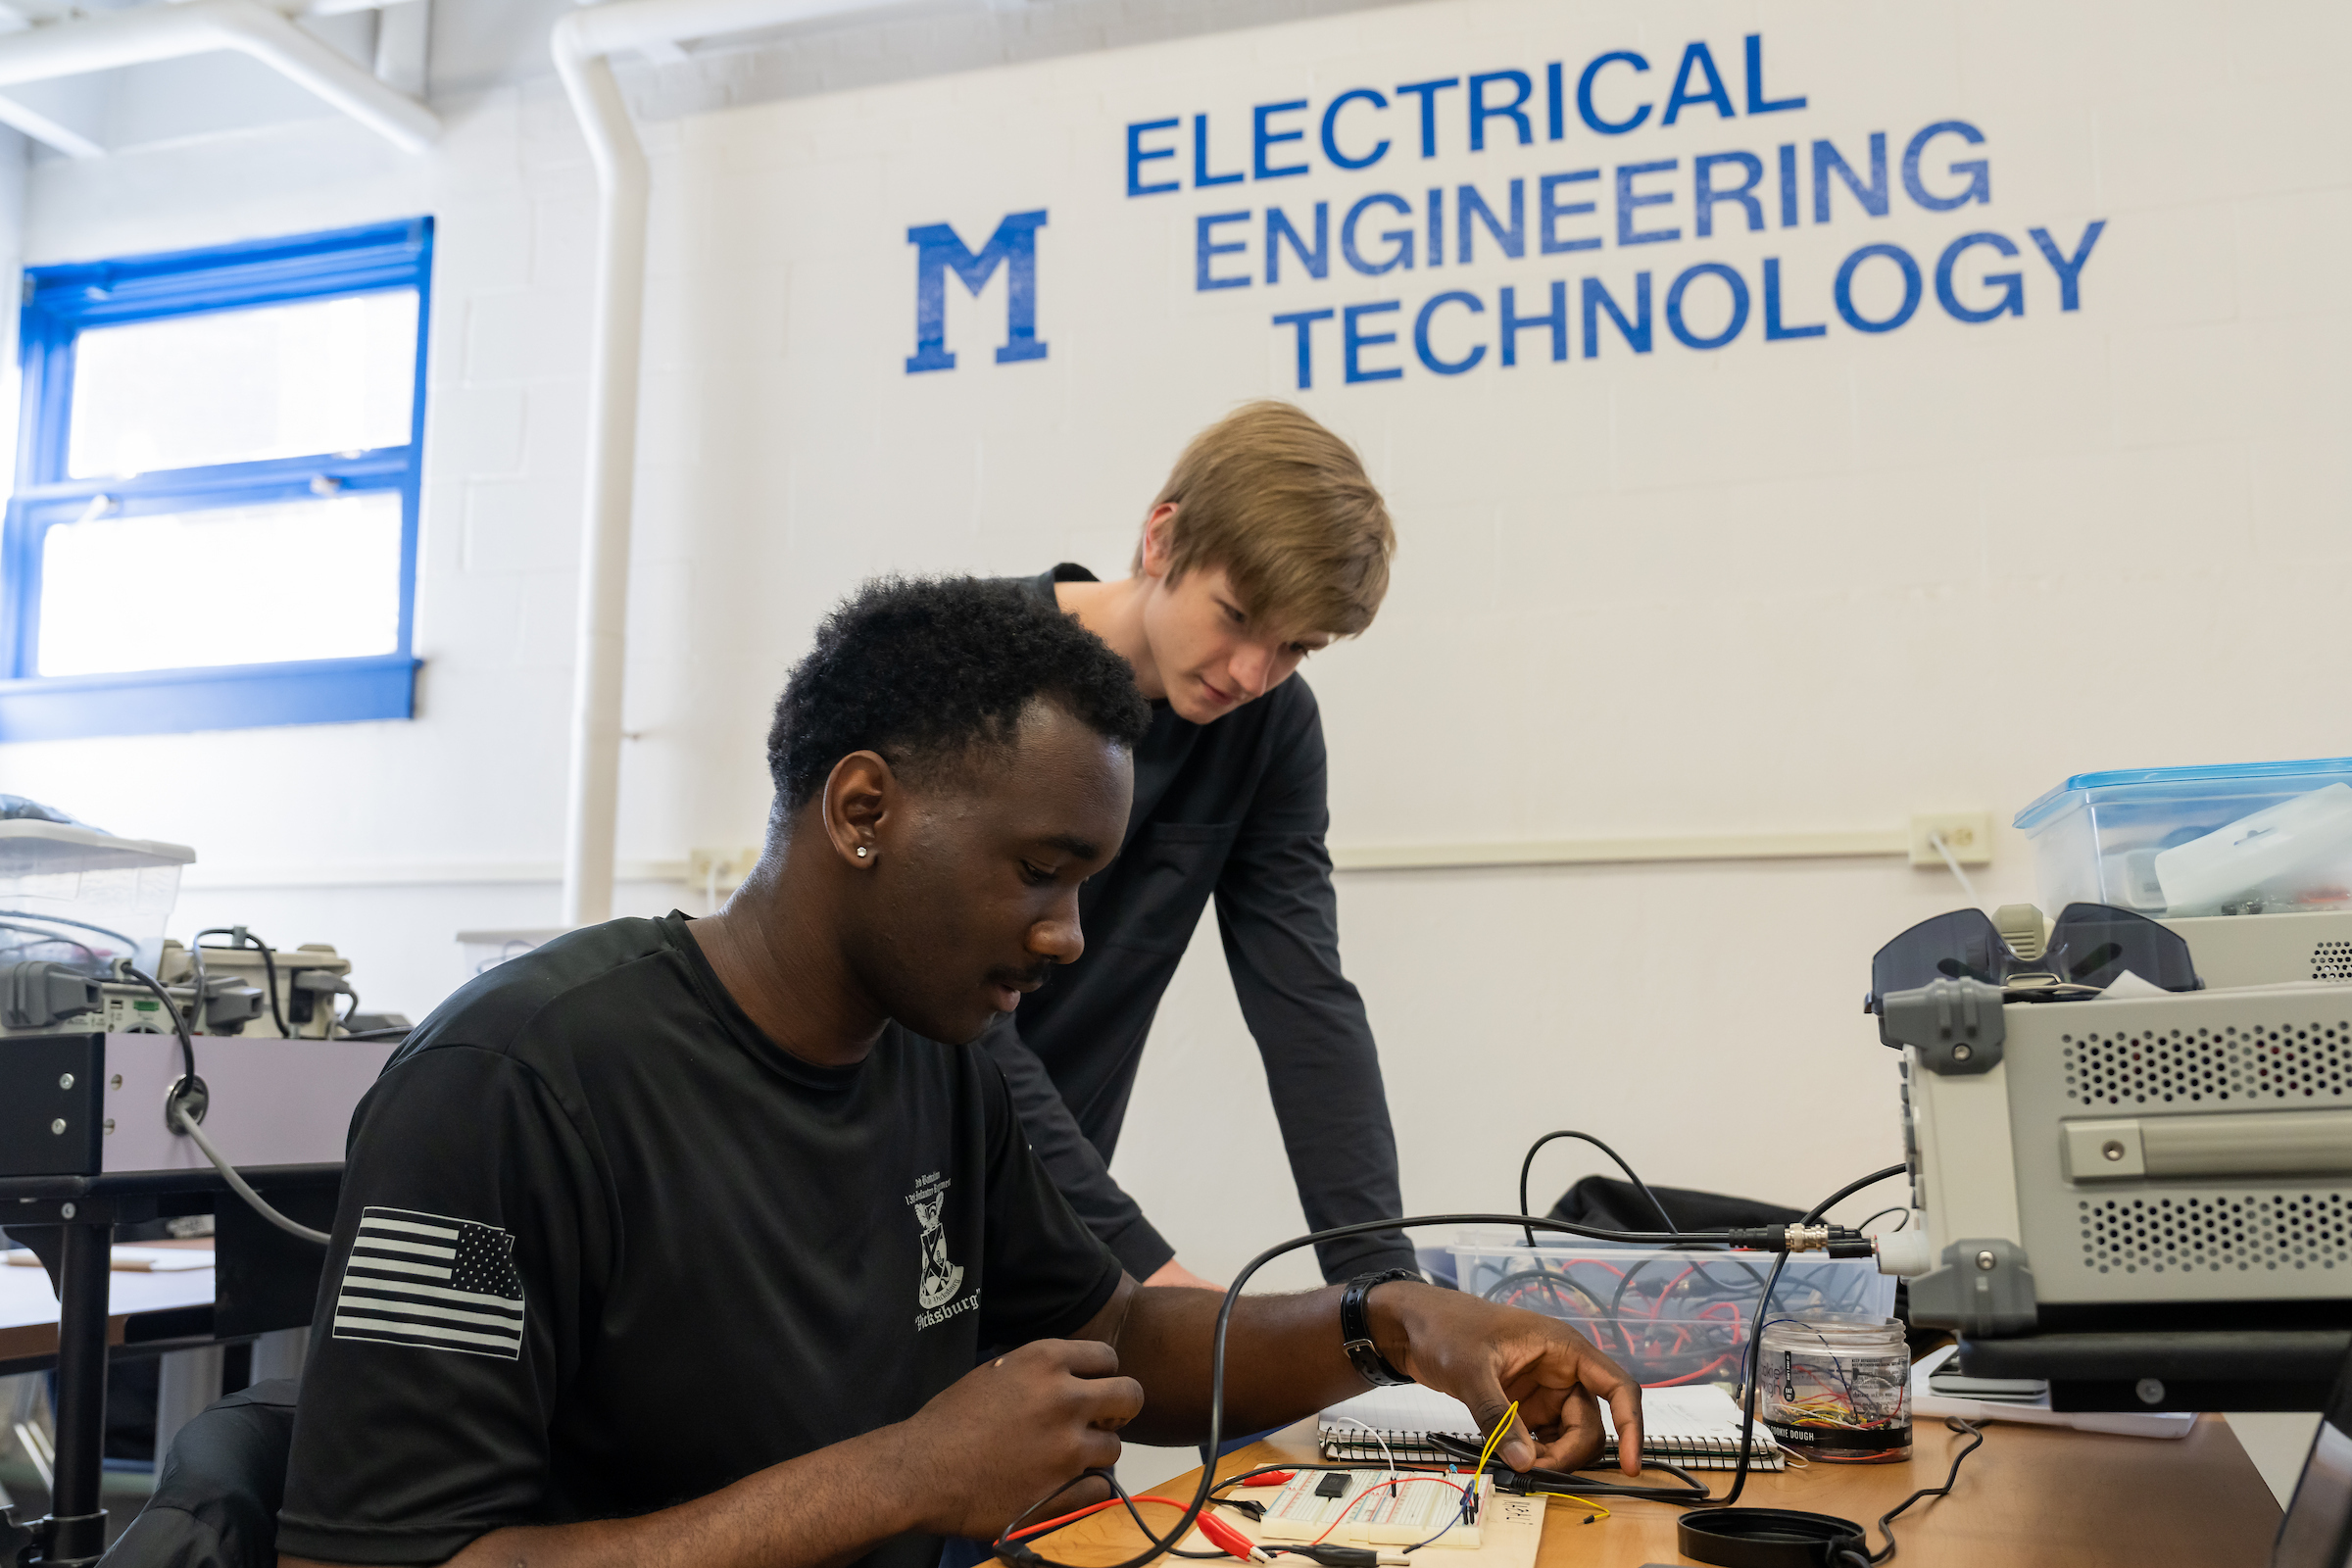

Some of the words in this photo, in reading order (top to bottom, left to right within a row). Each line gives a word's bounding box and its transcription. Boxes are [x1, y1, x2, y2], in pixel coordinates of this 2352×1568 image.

[1126, 34, 1807, 198] ELECTRICAL
[1197, 121, 1989, 292] ENGINEERING
[904, 208, 1049, 374] M
[1272, 220, 2105, 389] TECHNOLOGY
[1789, 1430, 1814, 1442] DOUGH
